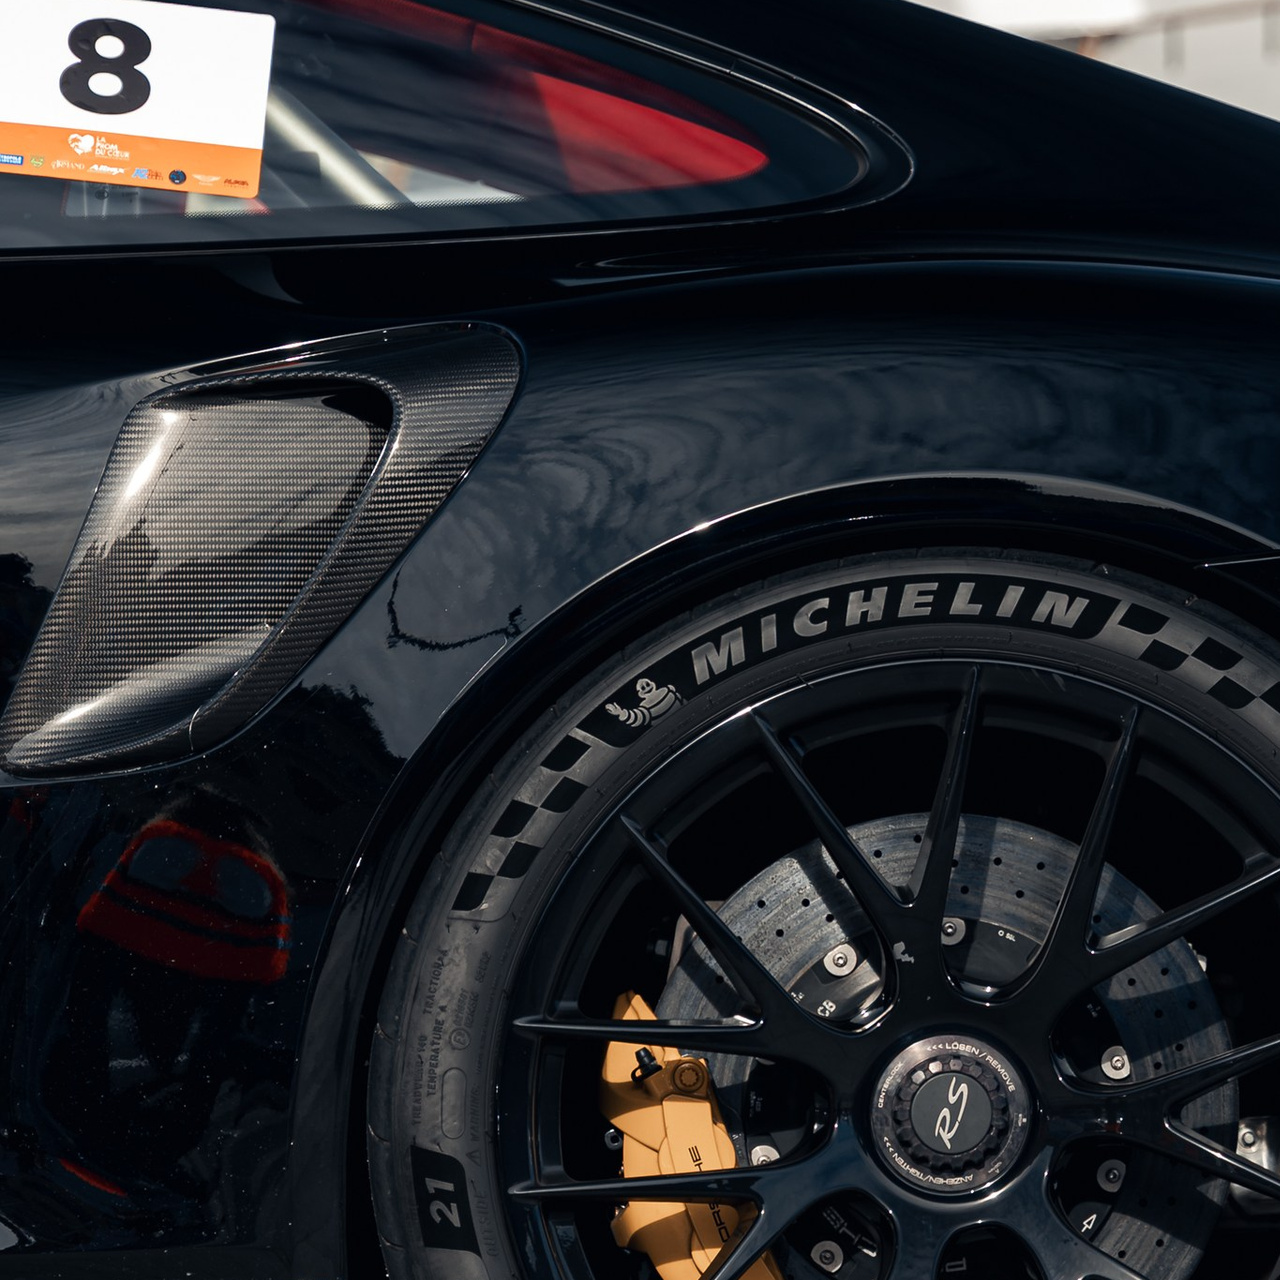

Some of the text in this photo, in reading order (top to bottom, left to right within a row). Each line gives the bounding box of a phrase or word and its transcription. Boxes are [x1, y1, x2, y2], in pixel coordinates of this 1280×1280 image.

[60, 18, 152, 115] 8
[691, 582, 1090, 685] MICHELIN
[425, 1018, 445, 1096] TEMPERATURE
[878, 1061, 904, 1108] CENTERLOCK
[945, 1042, 980, 1055] LÖSEN
[986, 1055, 1015, 1092] REMOVE
[934, 1076, 969, 1150] RS
[425, 1178, 461, 1228] 21
[472, 1190, 500, 1260] OUTSIDE
